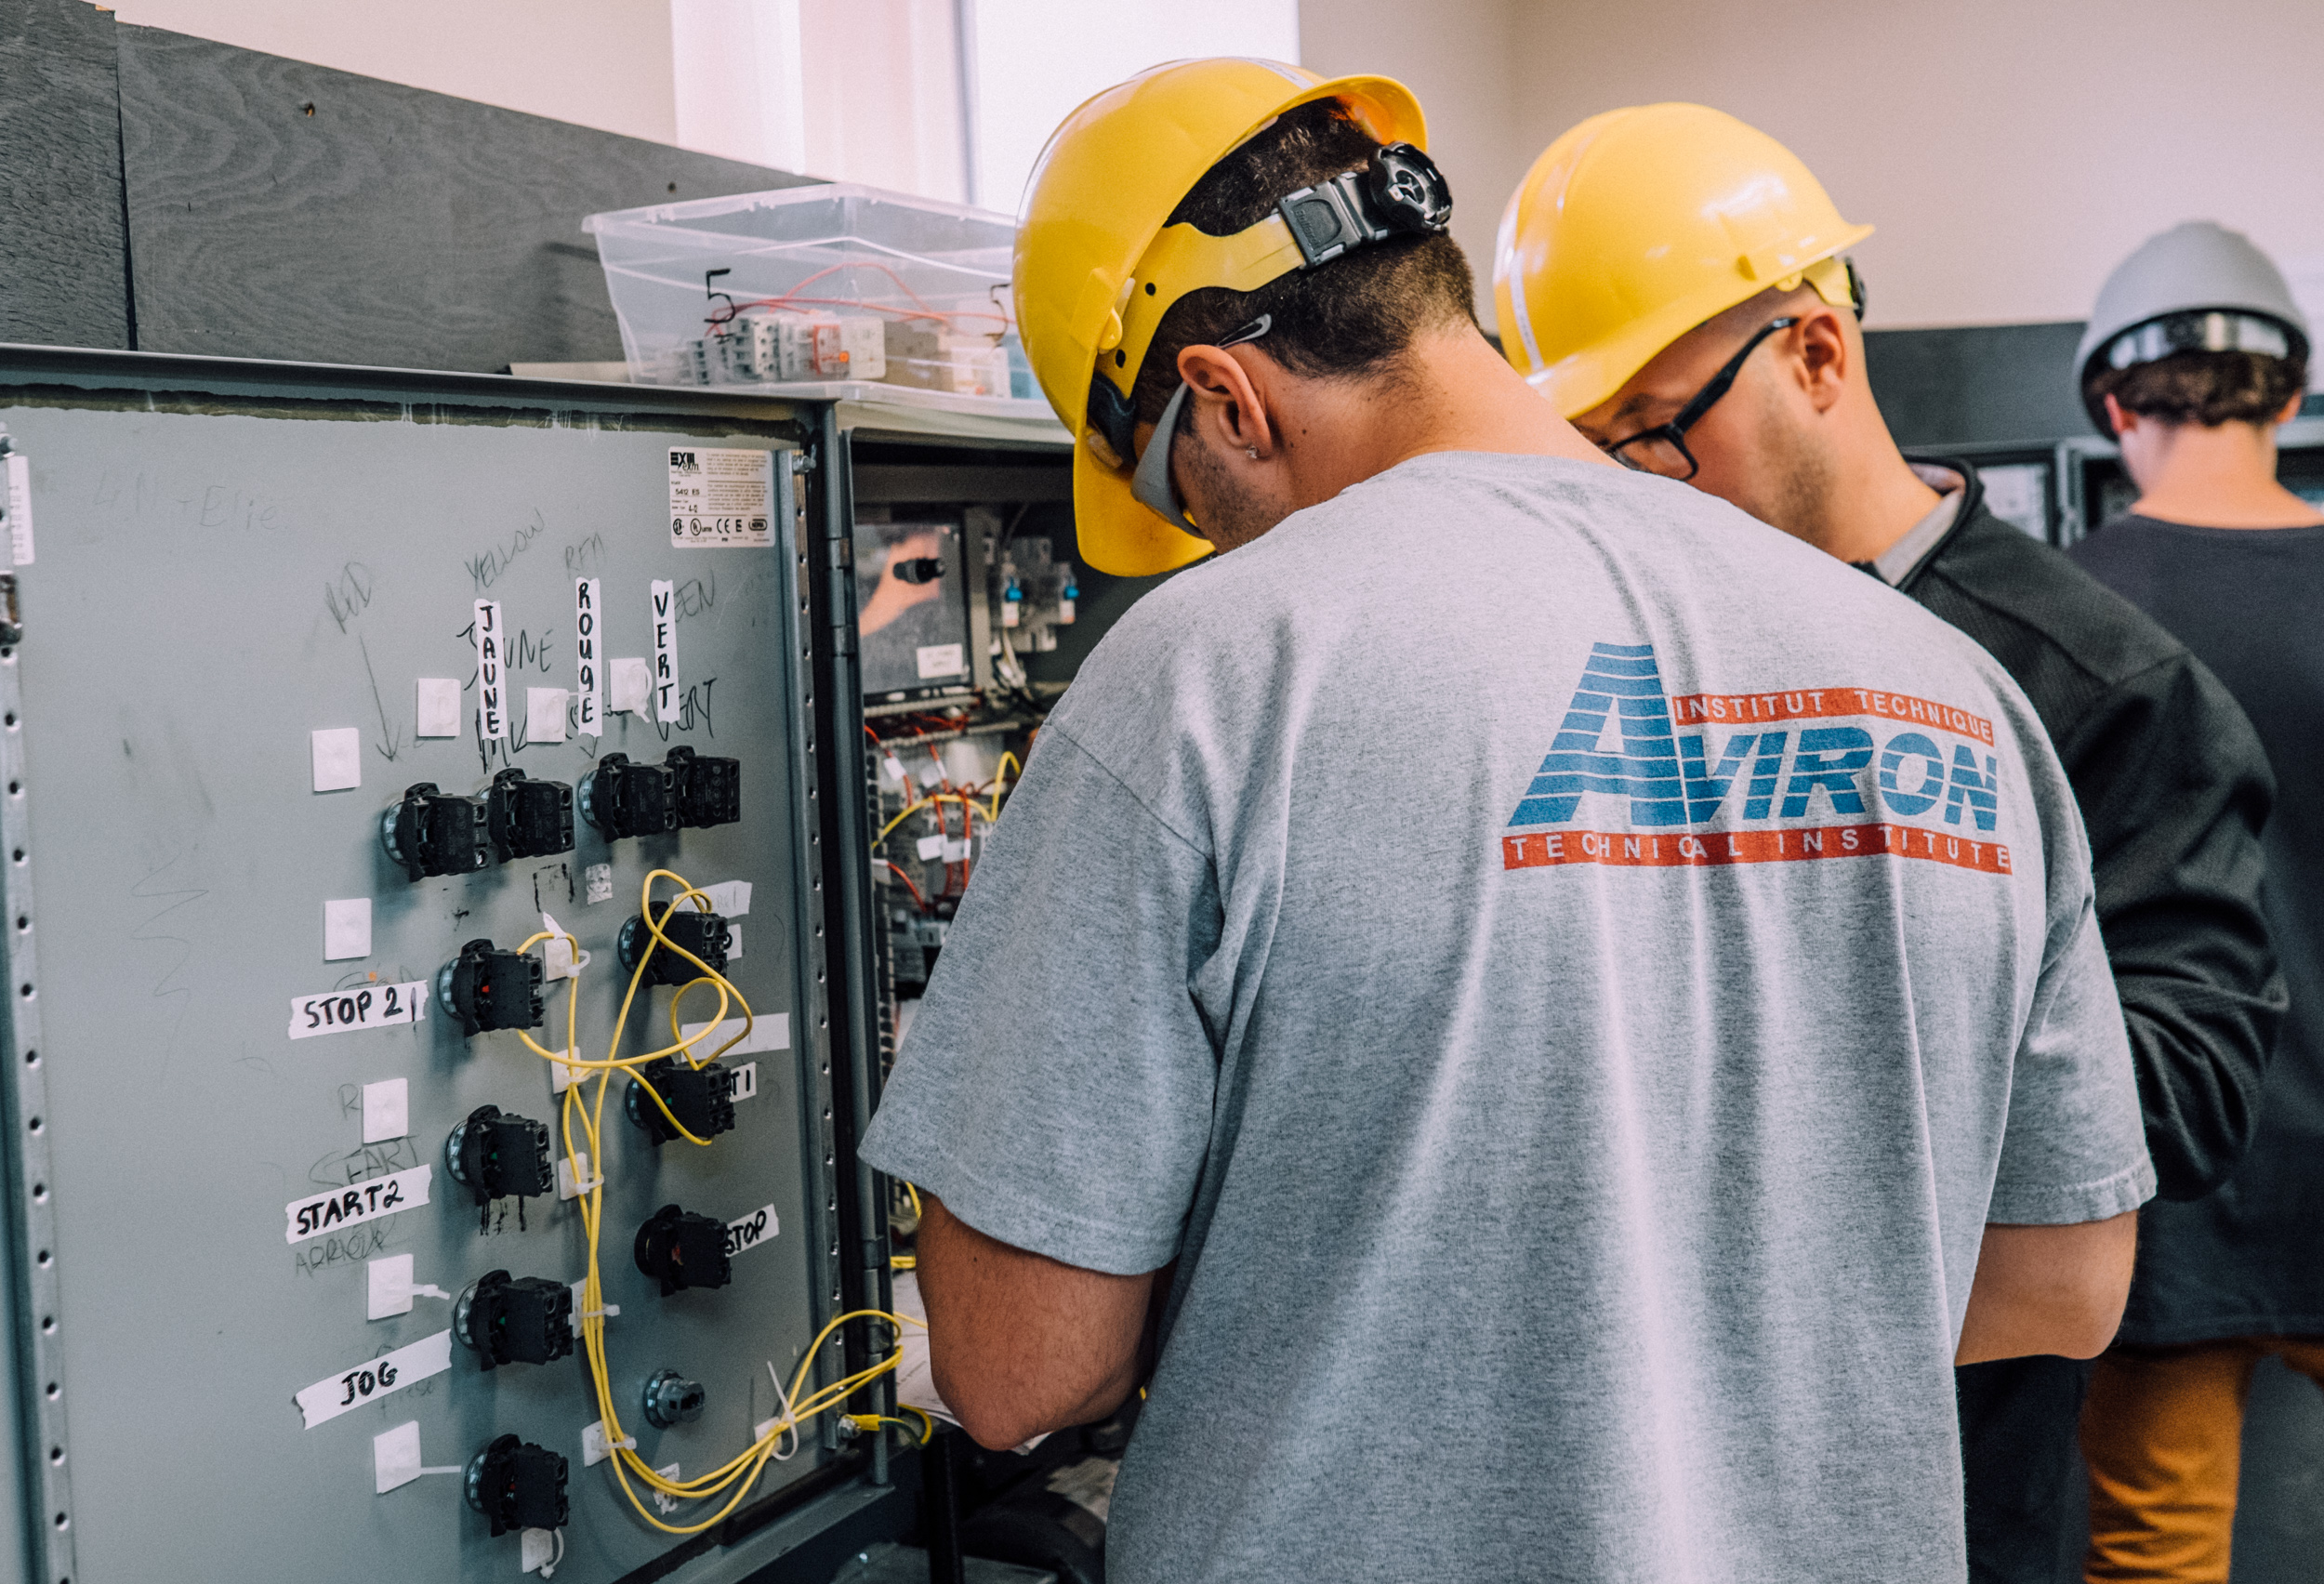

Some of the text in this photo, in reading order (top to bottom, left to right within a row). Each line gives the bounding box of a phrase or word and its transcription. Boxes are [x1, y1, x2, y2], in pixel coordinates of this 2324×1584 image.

[704, 267, 737, 323] 5
[984, 283, 1011, 340] 5
[464, 508, 545, 591] YELLOW
[479, 605, 500, 735] JAUNE
[654, 591, 674, 709] VERT
[1507, 641, 1998, 831] AVIRON
[1675, 690, 1993, 744] INSTITUT TECHNIQUE
[1509, 828, 2010, 868] TECHNICAL INSTITUTE
[304, 986, 403, 1029] STOP 2
[340, 1361, 398, 1406] JOG
